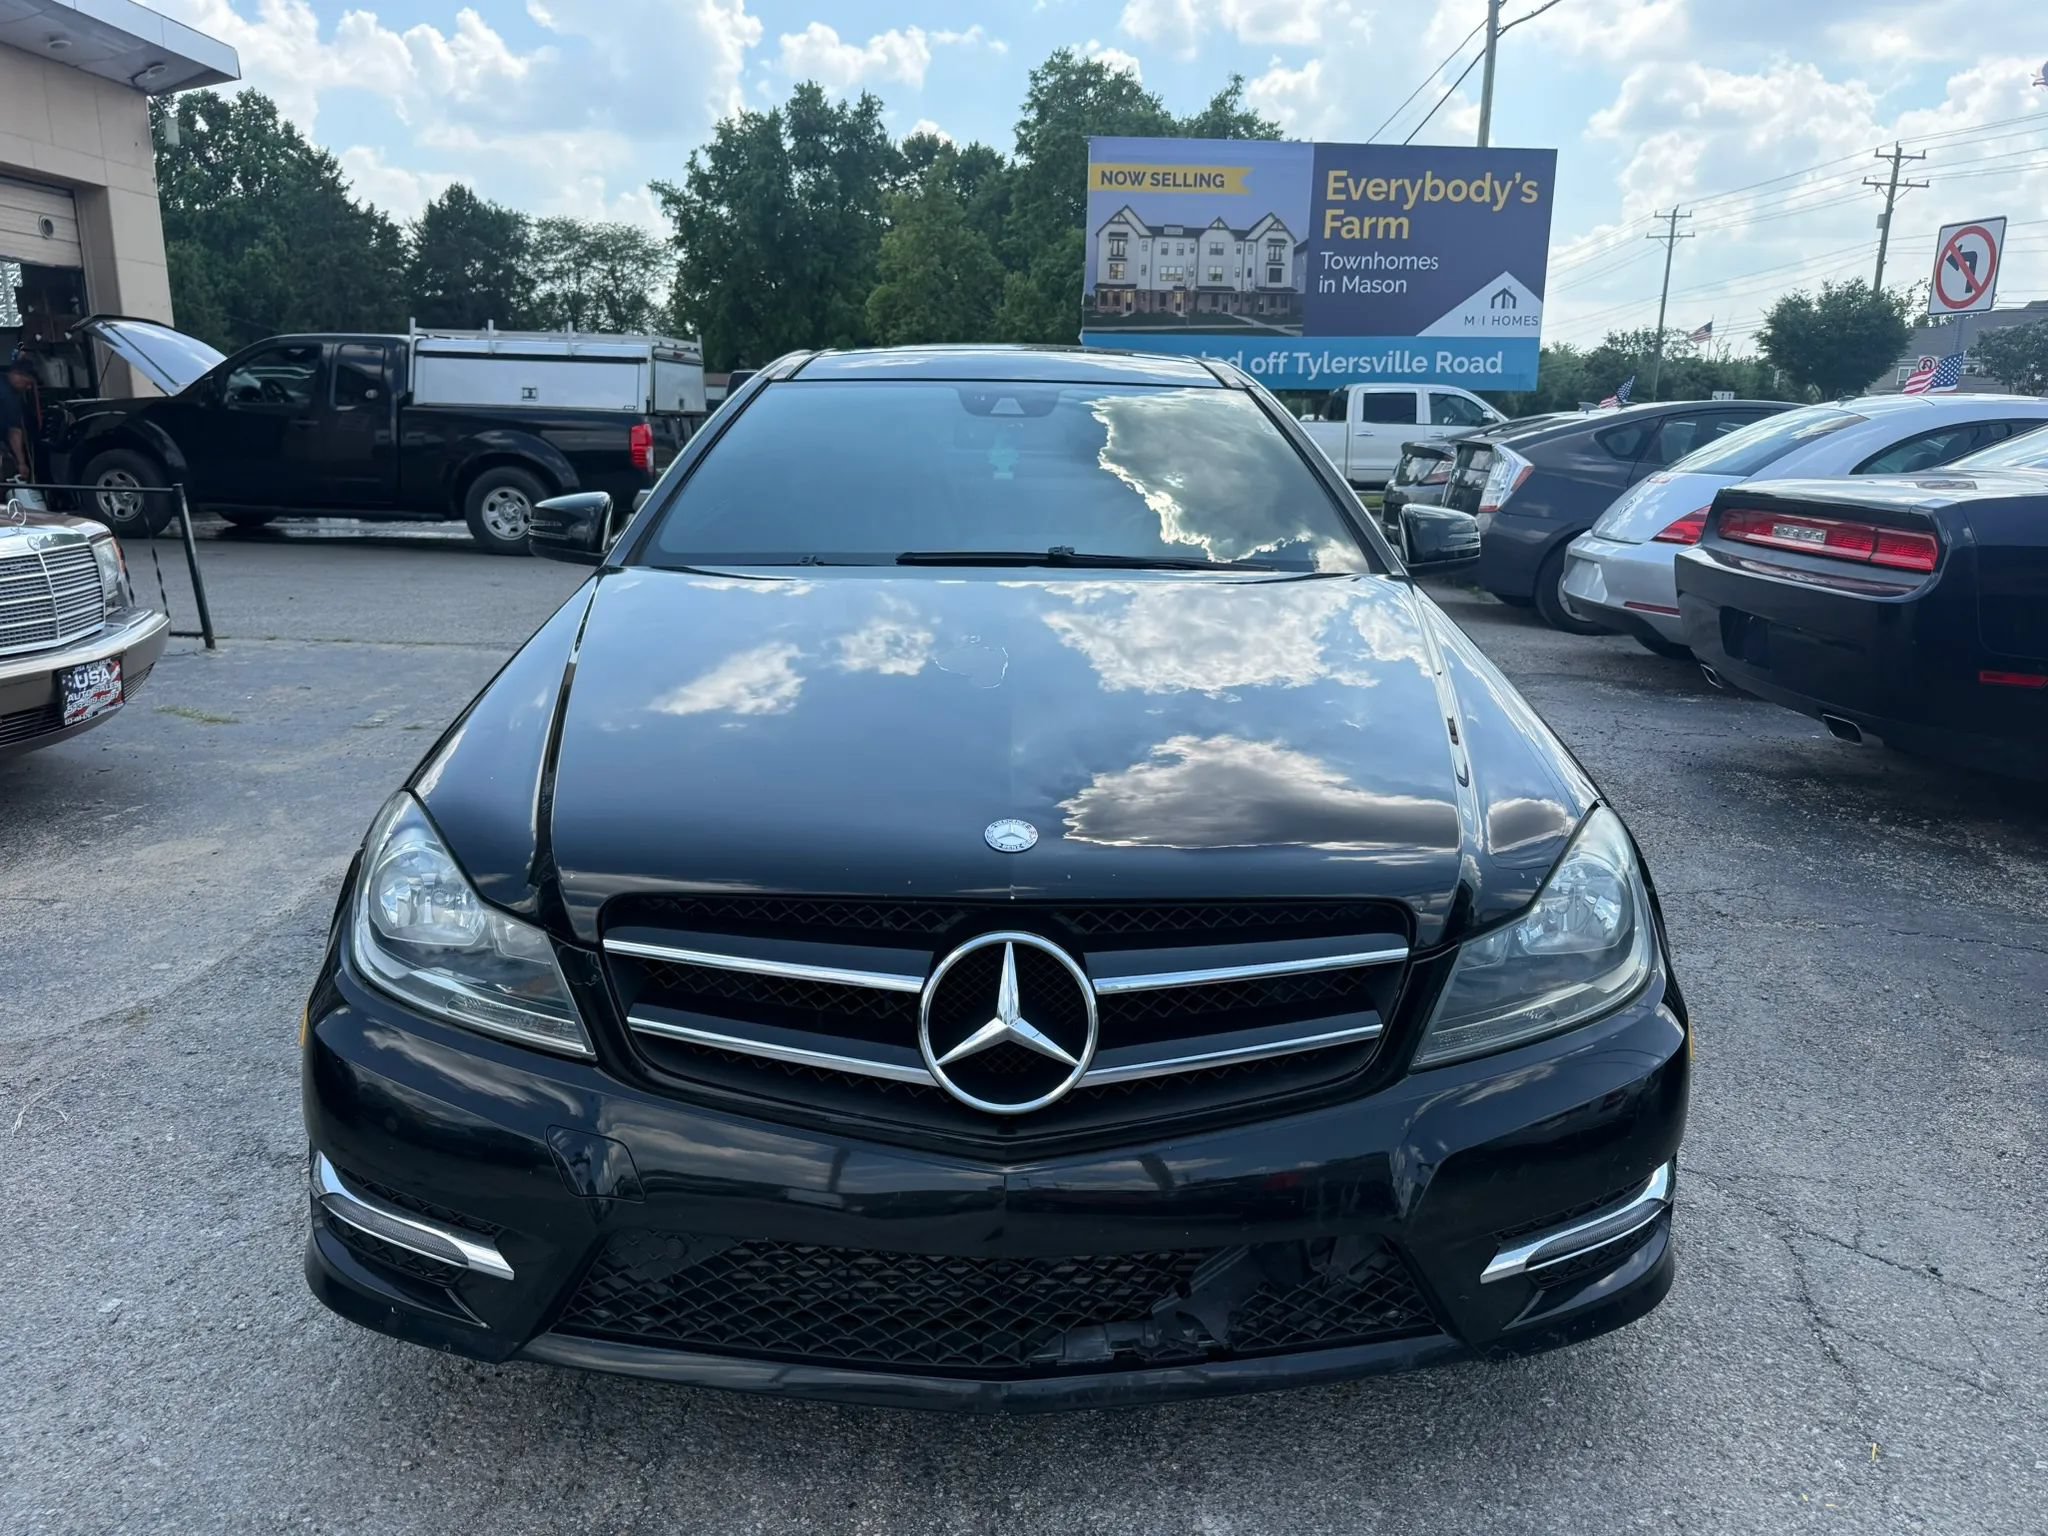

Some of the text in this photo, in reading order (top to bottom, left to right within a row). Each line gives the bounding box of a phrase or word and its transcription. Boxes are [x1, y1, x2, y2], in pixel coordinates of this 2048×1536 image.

[1100, 170, 1225, 188] NOW SELLING
[1326, 169, 1539, 212] Everybody's
[1323, 208, 1410, 240] Farm
[1319, 251, 1439, 270] Townhomes
[1318, 275, 1408, 294] in Mason
[1491, 315, 1539, 327] HOMES
[1250, 351, 1289, 375] off
[1292, 350, 1428, 381] Tylersville
[1434, 351, 1503, 374] Road
[74, 667, 111, 689] USA
